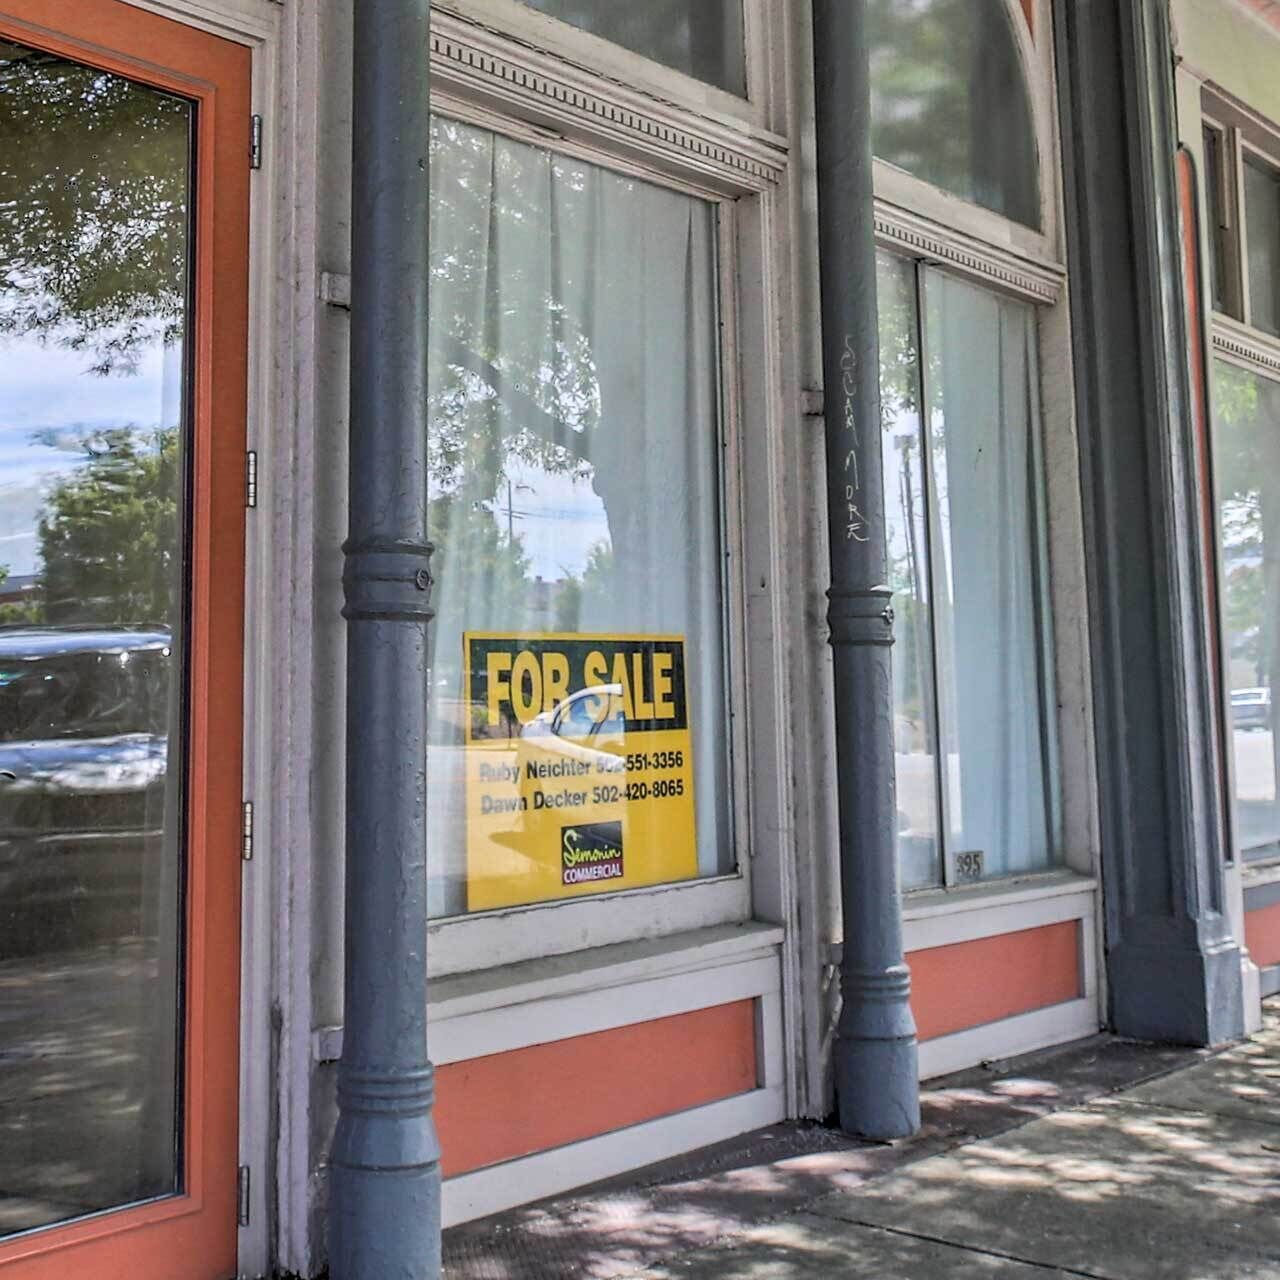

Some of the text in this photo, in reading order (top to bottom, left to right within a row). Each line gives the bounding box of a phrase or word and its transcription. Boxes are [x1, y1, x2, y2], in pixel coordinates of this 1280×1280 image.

[487, 650, 675, 726] FOR SALE
[527, 757, 591, 779] Neichter
[481, 795, 527, 815] Dawn
[534, 789, 588, 810] Decker
[563, 829, 621, 867] Semonin
[564, 863, 622, 883] COMMERCIAL
